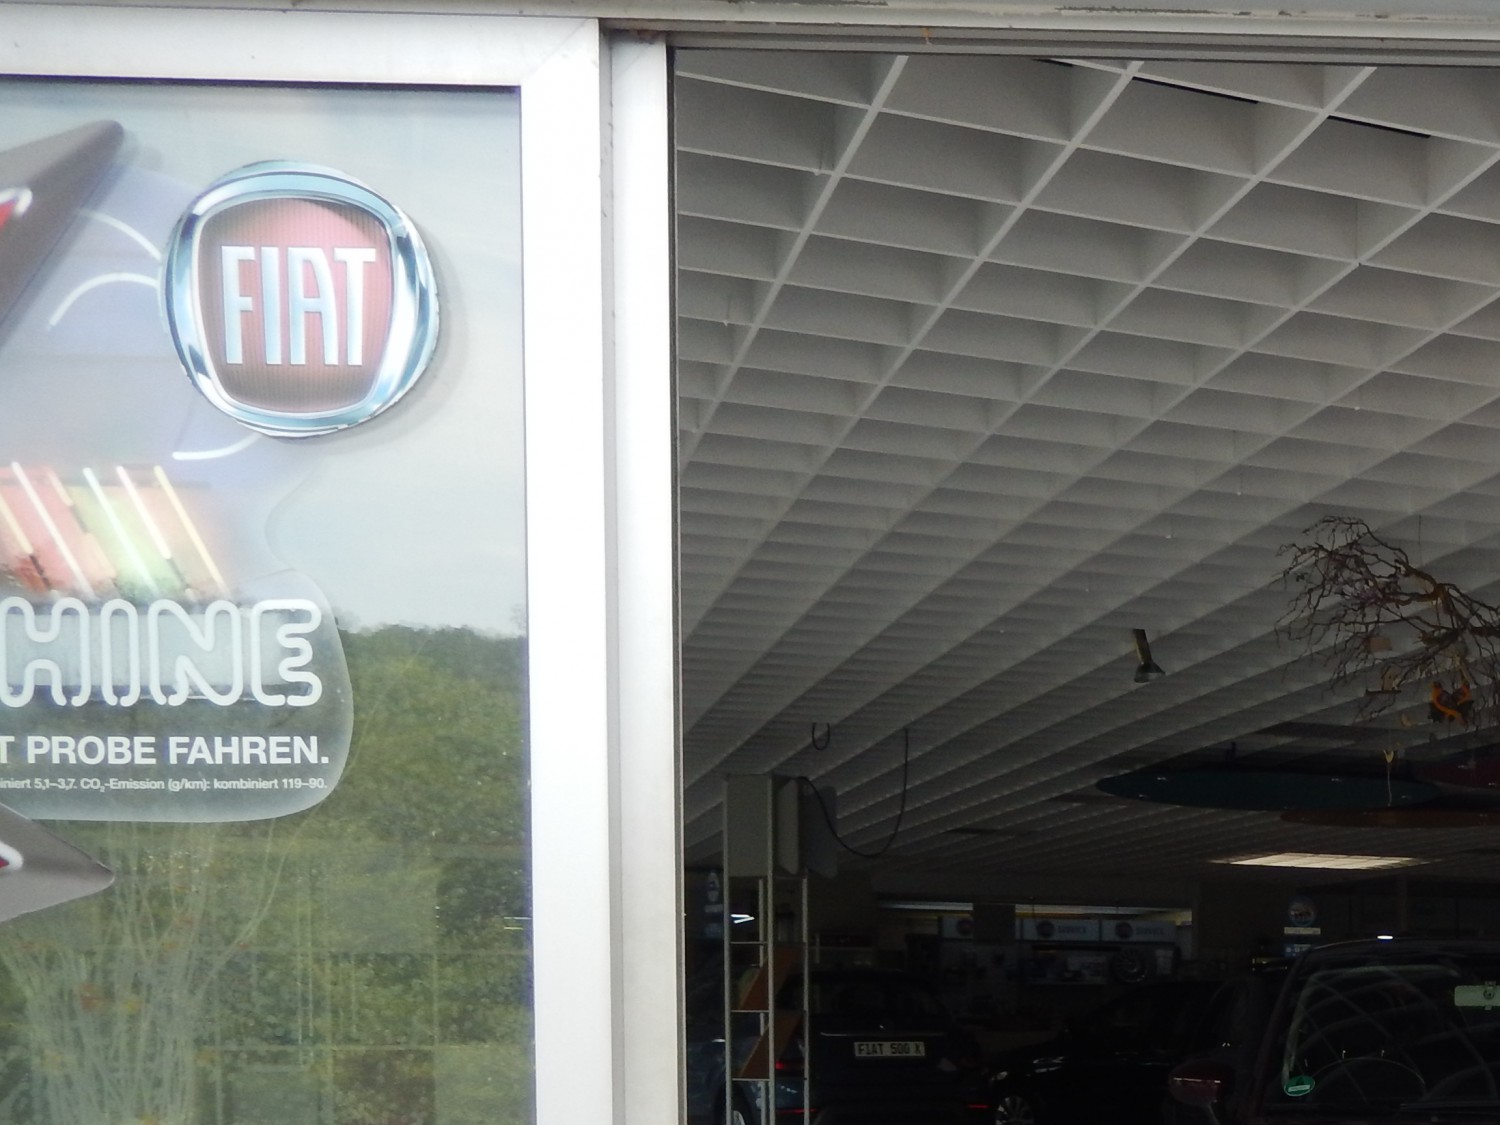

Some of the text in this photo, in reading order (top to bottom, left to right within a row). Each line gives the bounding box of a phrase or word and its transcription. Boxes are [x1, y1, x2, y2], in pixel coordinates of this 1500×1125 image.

[221, 245, 376, 365] FIAT
[1, 596, 323, 708] HINE
[27, 735, 157, 765] PROBE
[168, 735, 329, 765] FAHREN.
[168, 777, 210, 792] (g/km):
[213, 777, 279, 790] kombiniert
[857, 1043, 921, 1055] FIAT 500 X
